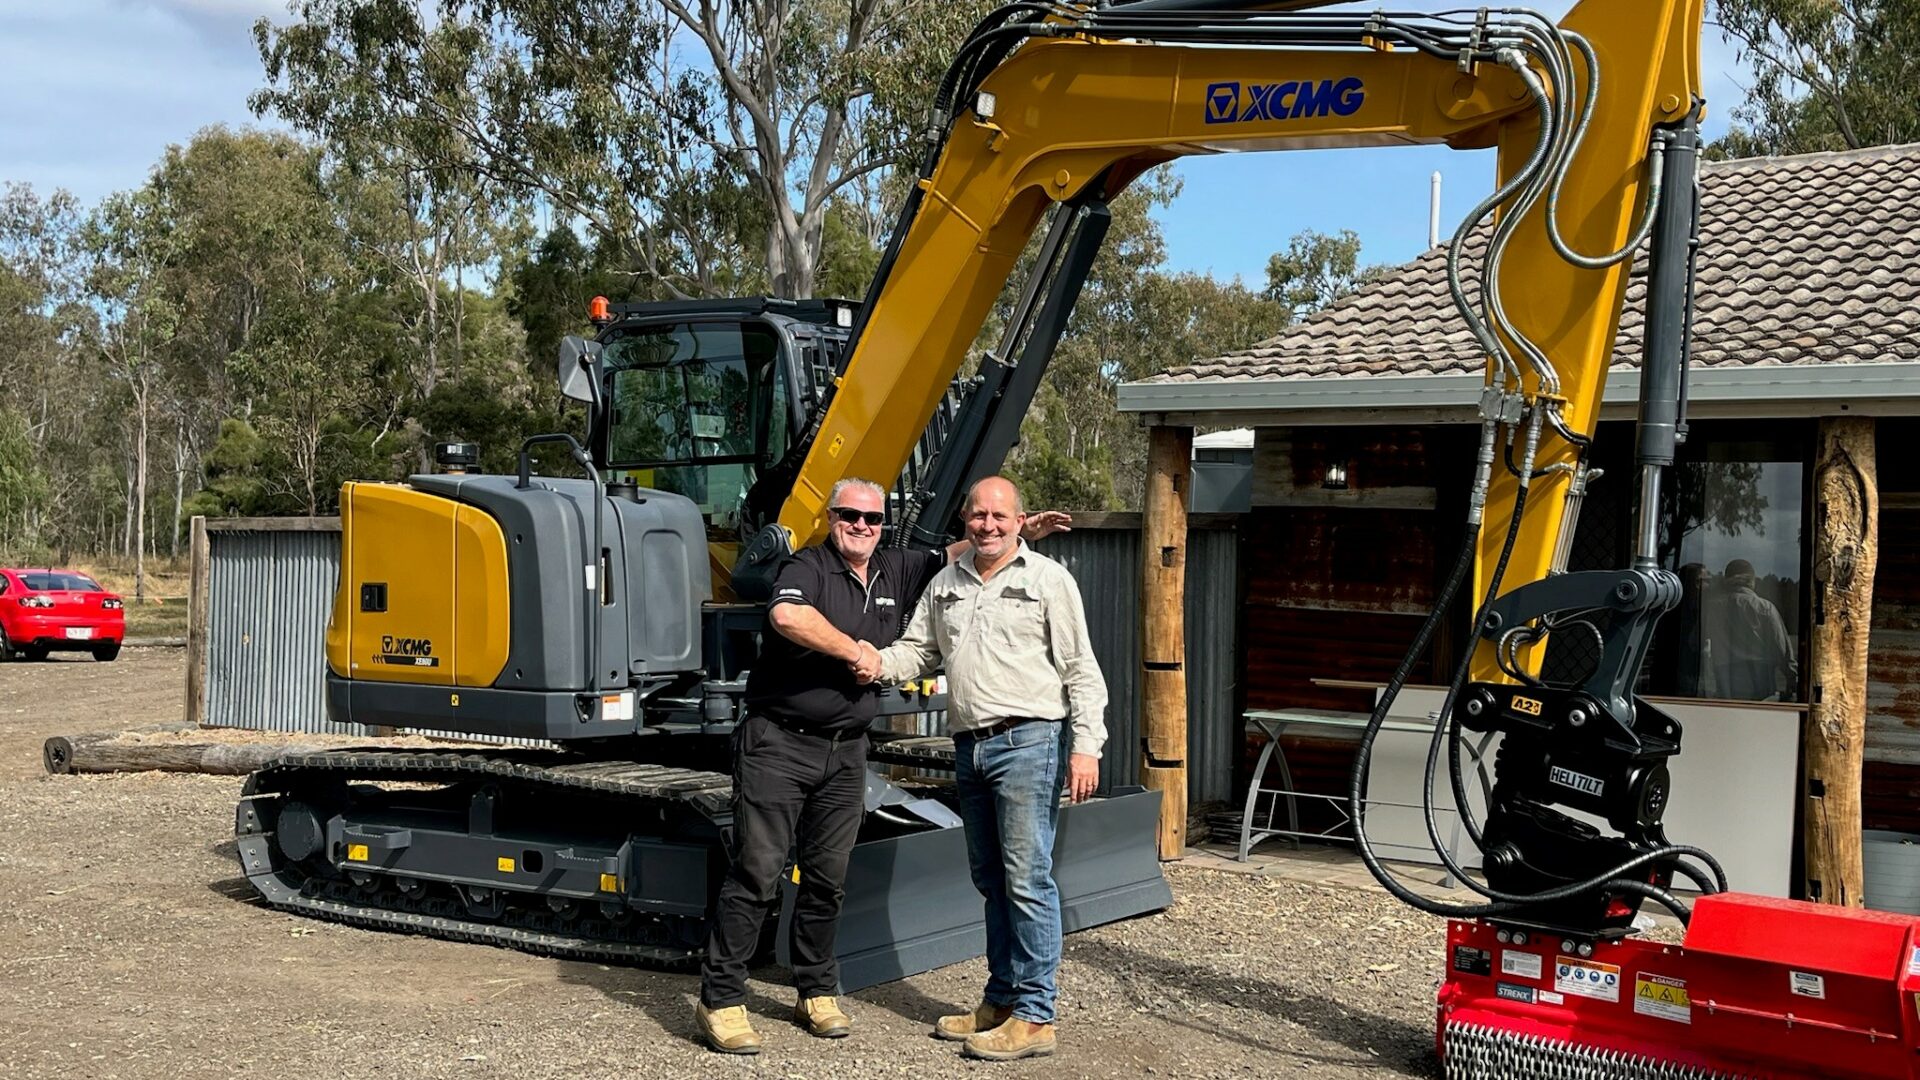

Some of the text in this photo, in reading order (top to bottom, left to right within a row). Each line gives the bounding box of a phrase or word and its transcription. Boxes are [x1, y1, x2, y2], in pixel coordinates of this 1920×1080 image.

[1237, 77, 1365, 122] XCMG
[393, 638, 432, 656] XCMG
[1657, 977, 1685, 988] DANGER
[1498, 987, 1531, 1000] STRENX
